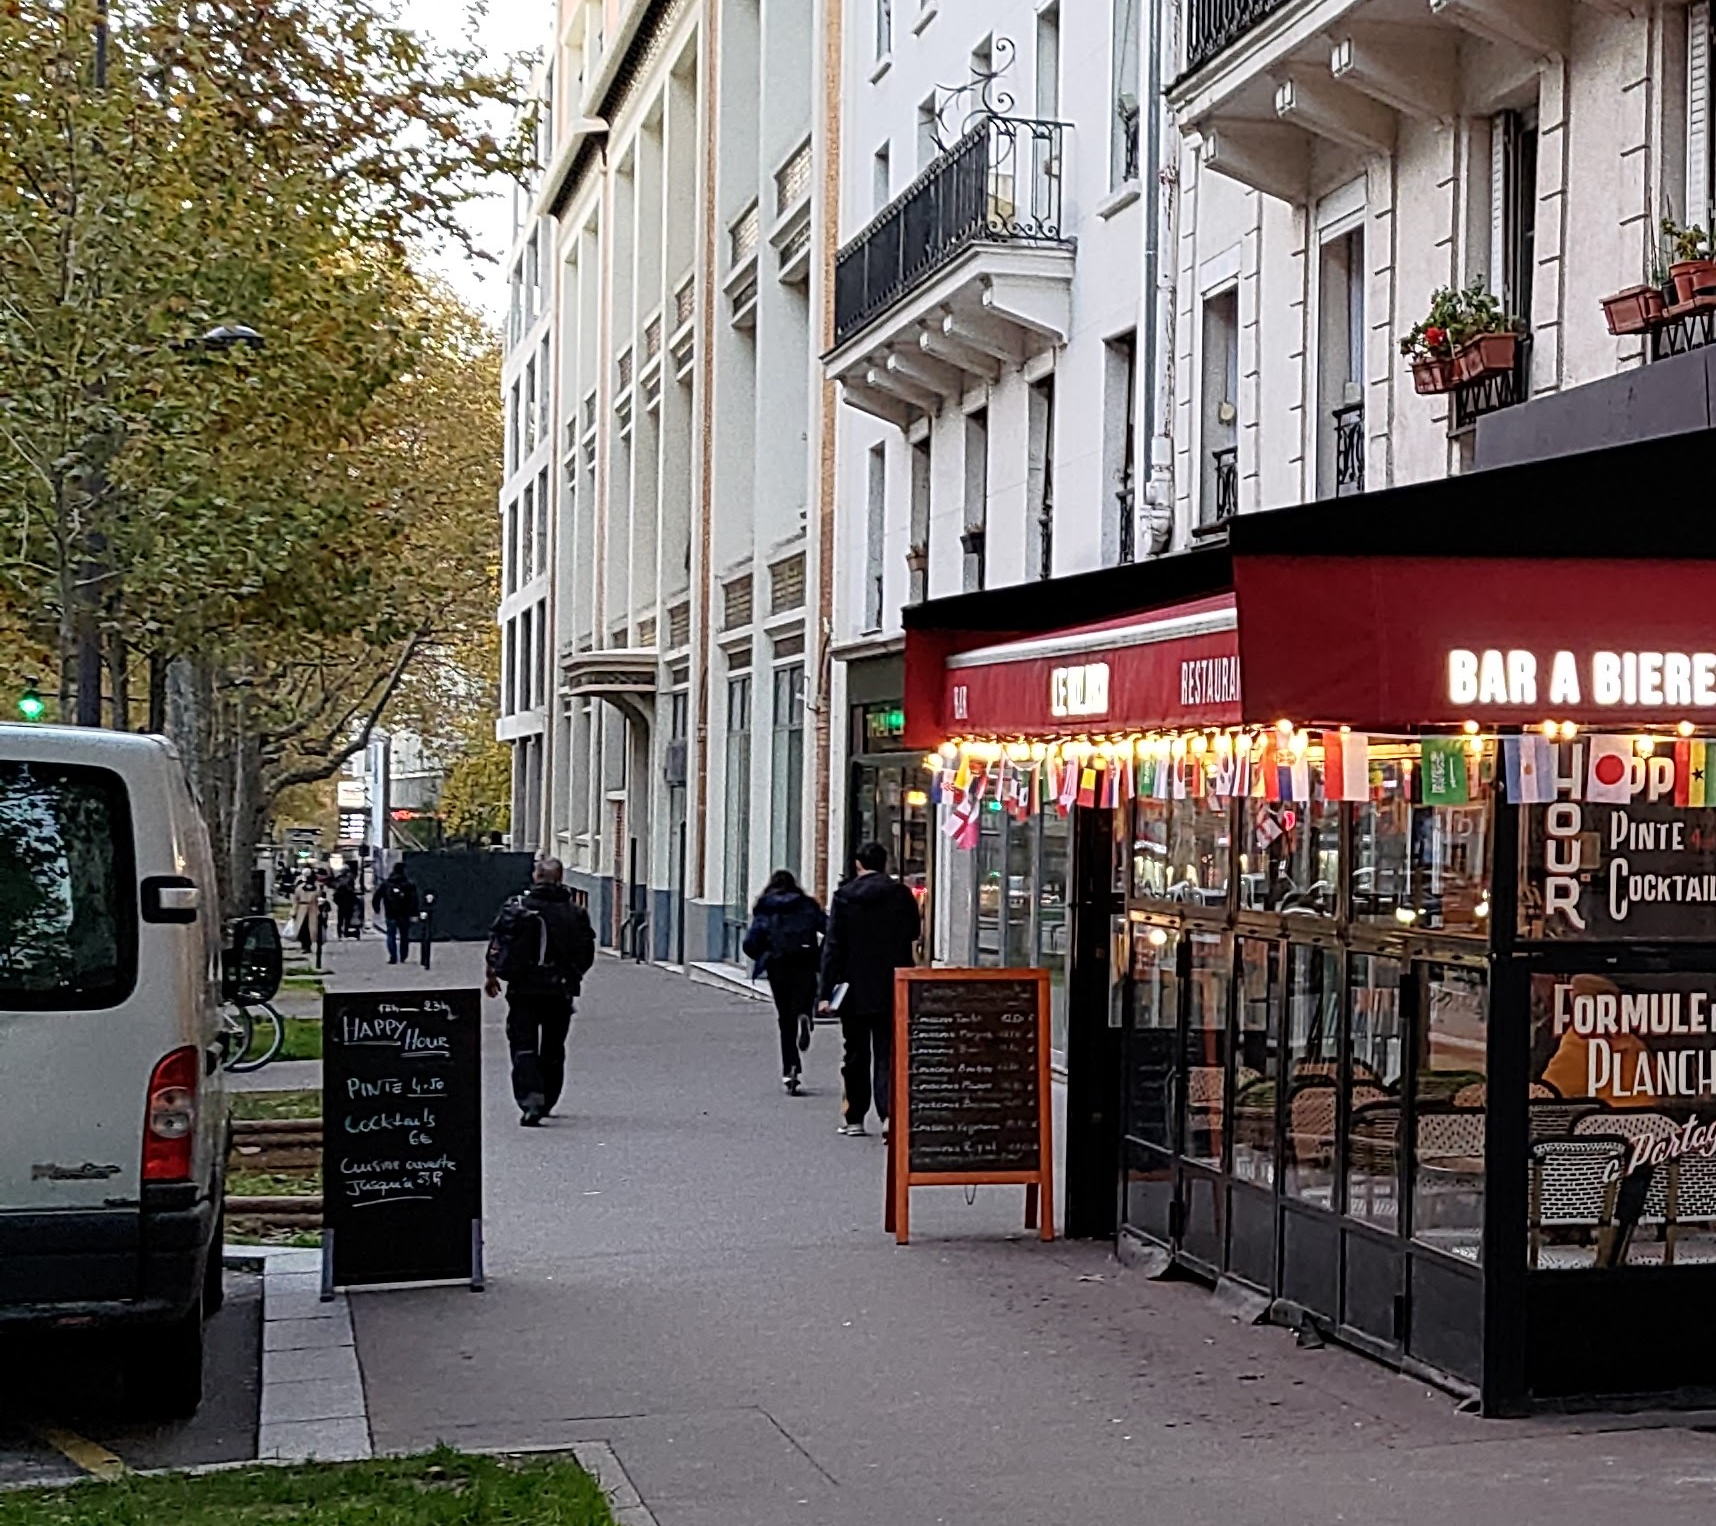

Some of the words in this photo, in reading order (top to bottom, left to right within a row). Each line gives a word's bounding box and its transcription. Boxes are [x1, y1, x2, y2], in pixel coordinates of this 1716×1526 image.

[1448, 649, 1537, 705] BAR
[1549, 650, 1581, 705] A
[1610, 810, 1685, 851] PINTE
[343, 1015, 407, 1041] HAPPY
[1554, 984, 1707, 1035] FORMULE
[347, 1077, 402, 1100] PINTE
